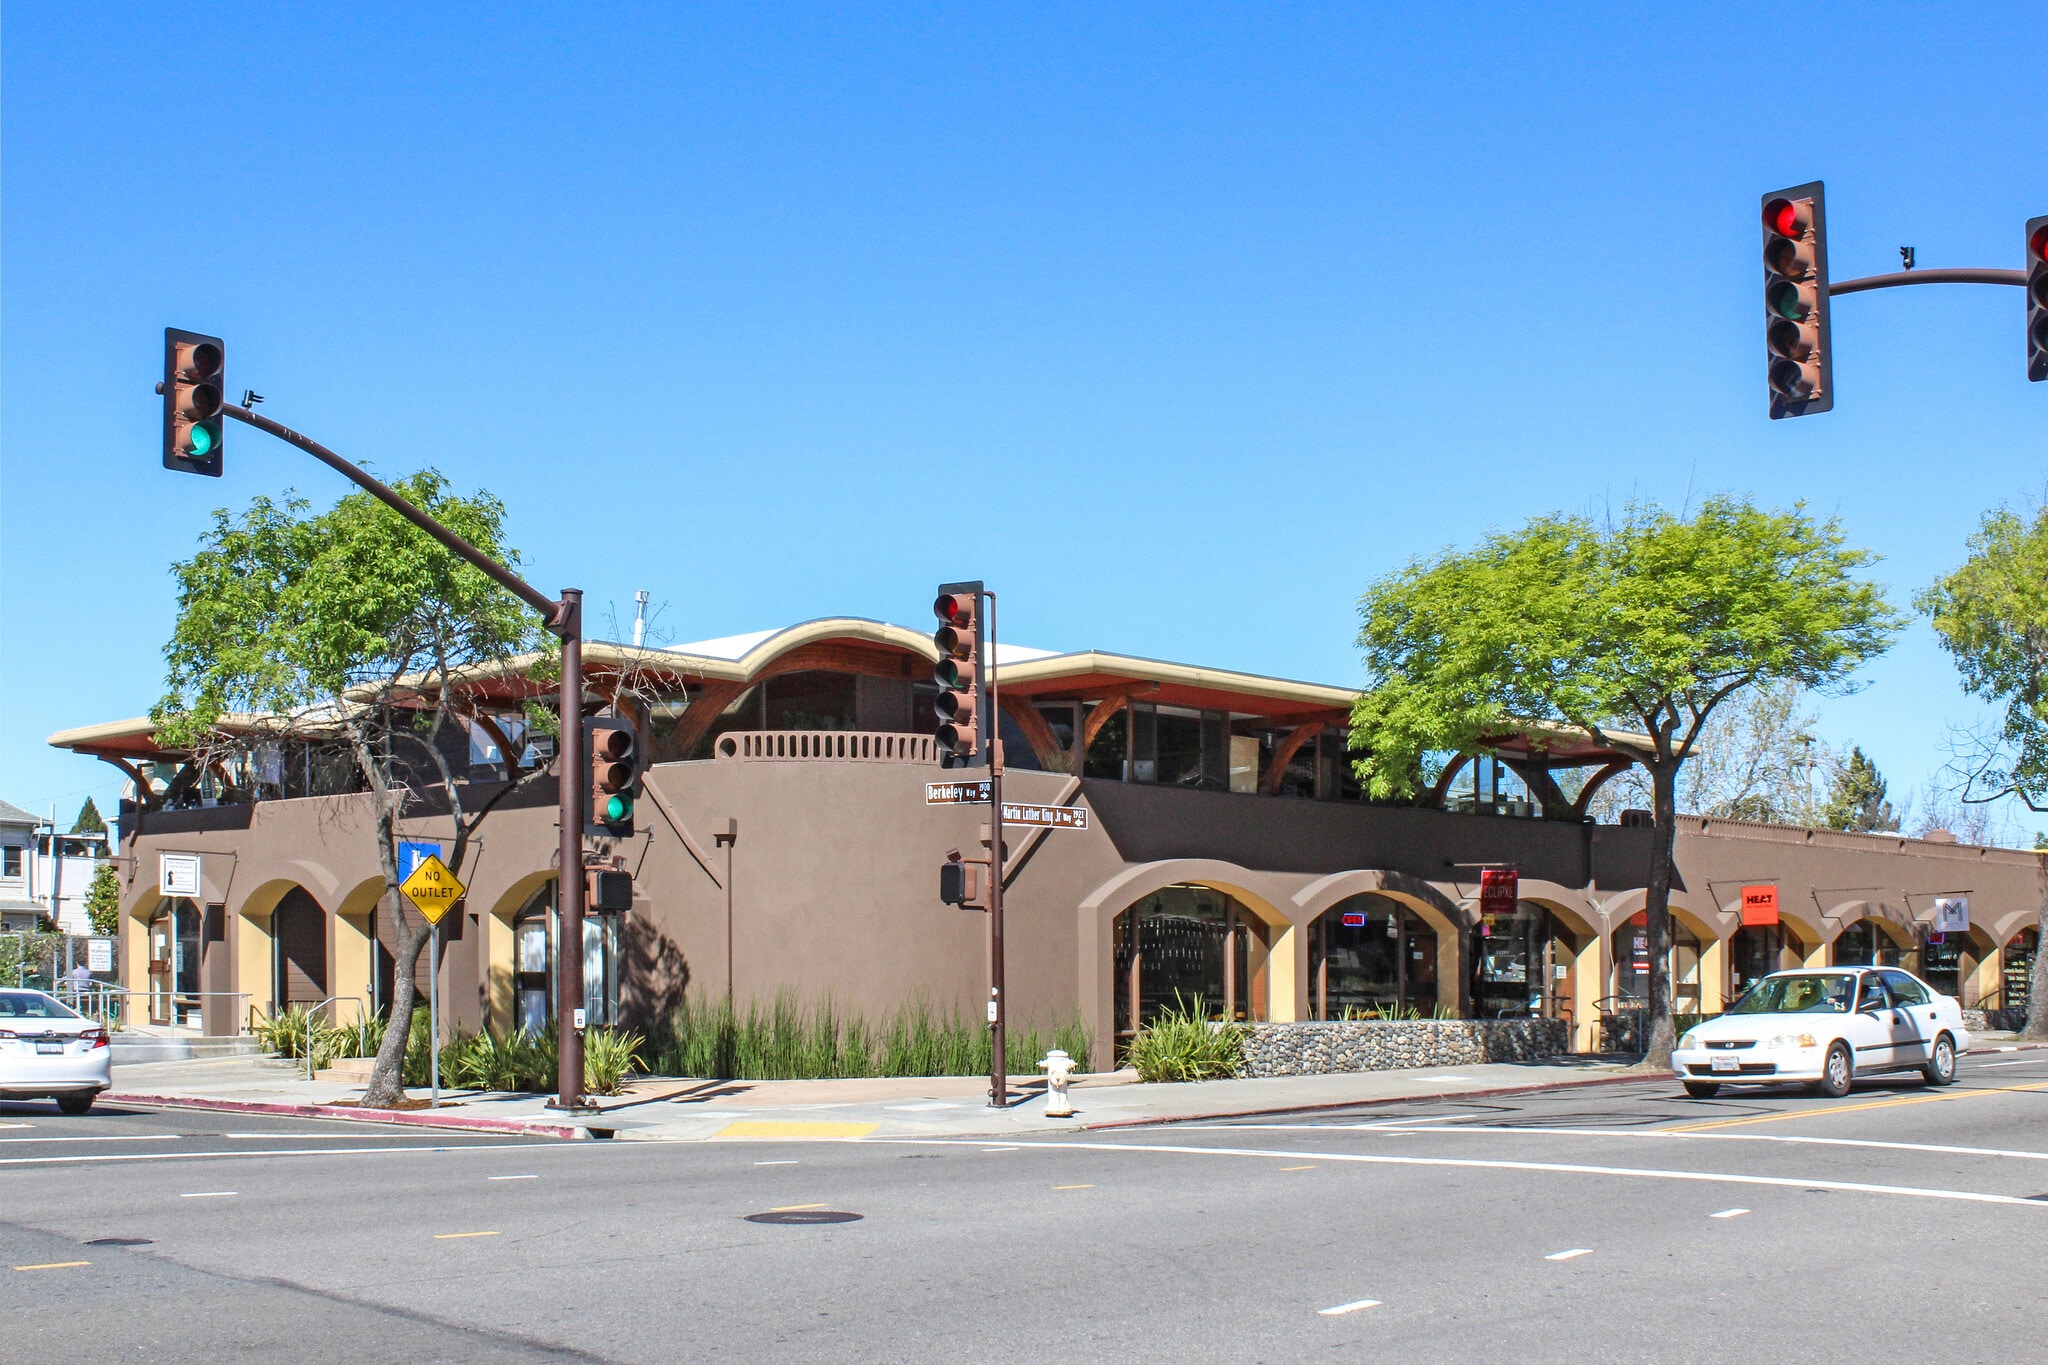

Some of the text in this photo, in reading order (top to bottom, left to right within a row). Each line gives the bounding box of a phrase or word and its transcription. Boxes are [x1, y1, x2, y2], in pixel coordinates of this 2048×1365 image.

[928, 784, 963, 802] Berkeley
[966, 788, 976, 798] Way
[1003, 805, 1020, 820] Martin
[1022, 806, 1040, 821] Luther
[1042, 808, 1053, 827] King
[1055, 808, 1062, 823] Jr
[1062, 812, 1072, 824] Way
[425, 871, 440, 881] NO
[412, 887, 454, 898] OUTLET
[1746, 894, 1773, 905] HEAT
[1343, 915, 1363, 925] OPEN
